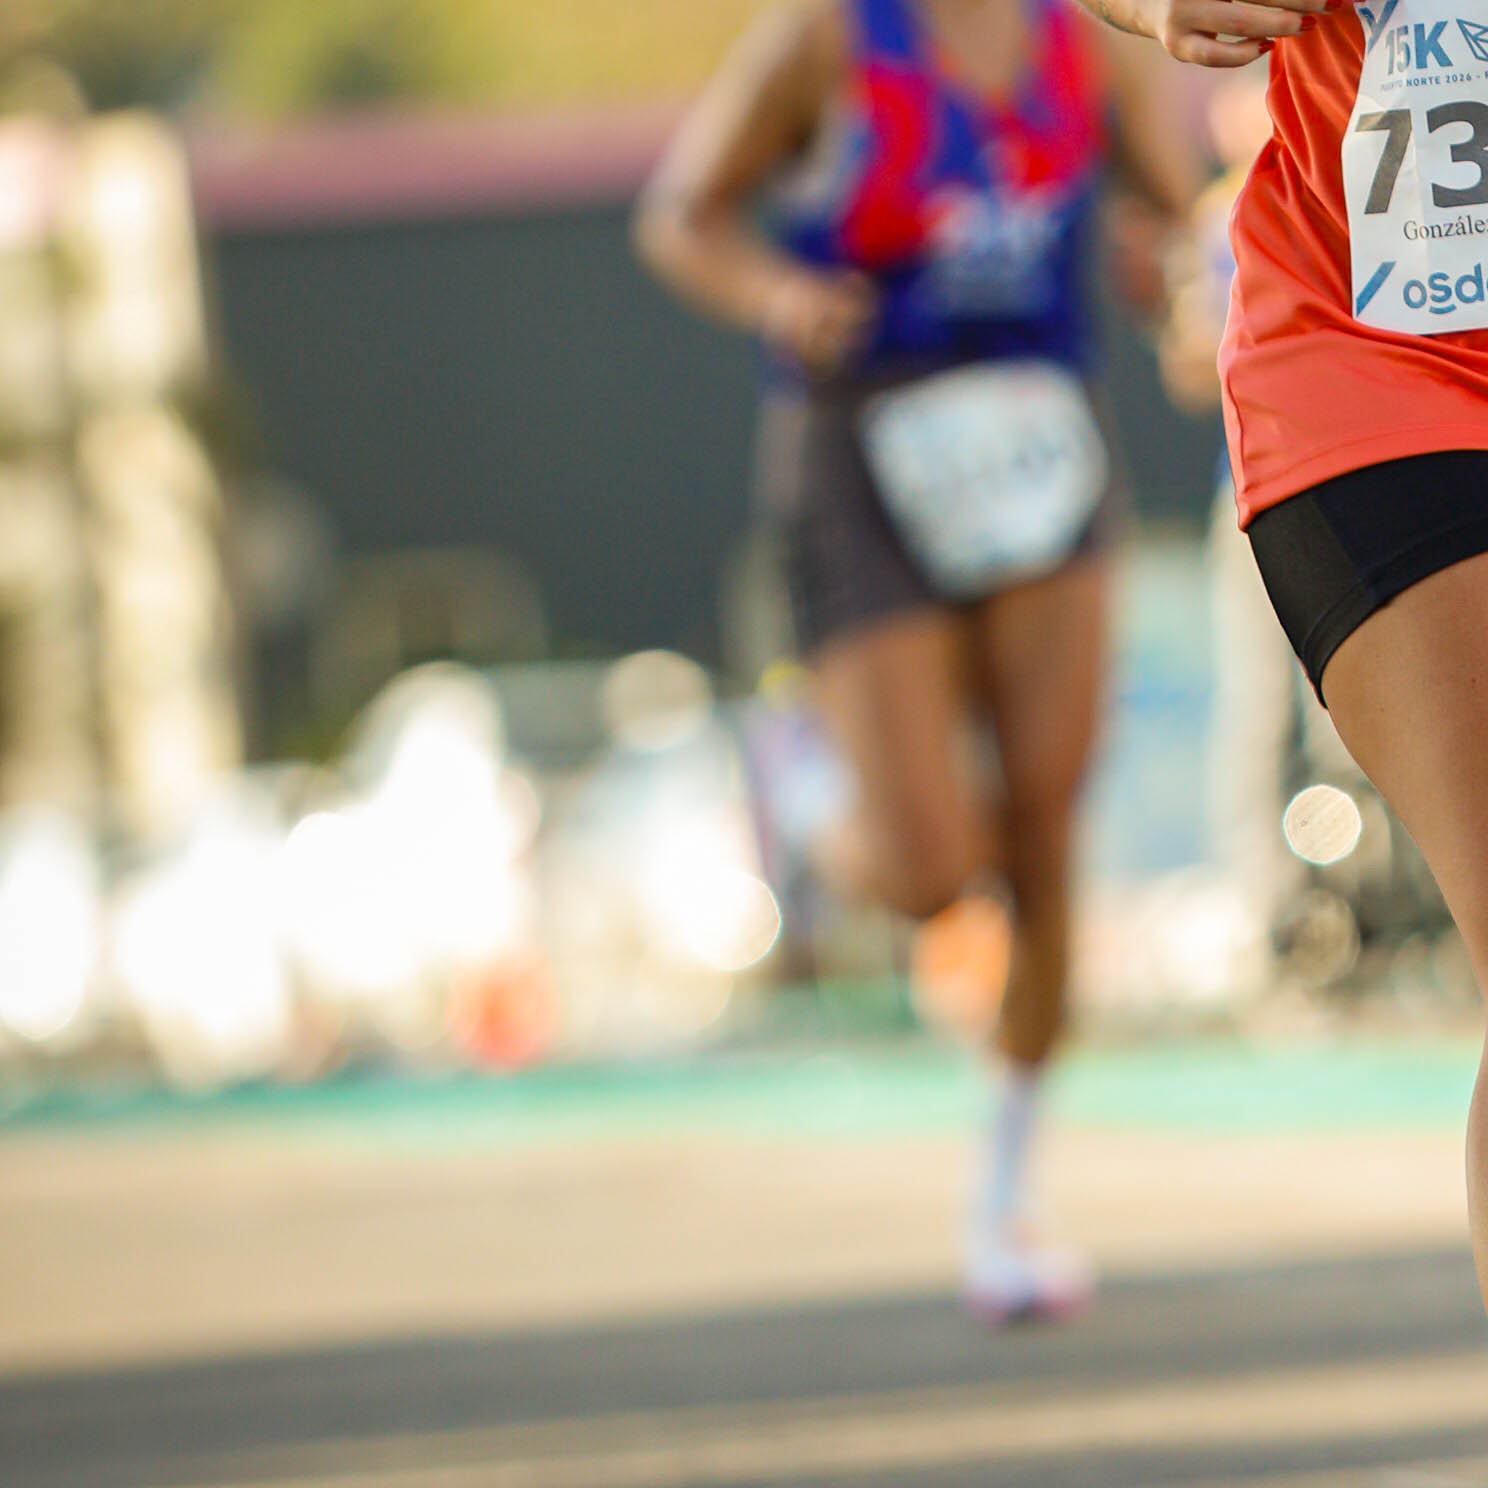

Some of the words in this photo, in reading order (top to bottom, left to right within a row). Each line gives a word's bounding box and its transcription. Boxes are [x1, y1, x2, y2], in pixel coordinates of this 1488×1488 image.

[1385, 20, 1454, 75] 15K
[1406, 75, 1441, 87] NORTE
[1446, 72, 1472, 84] 2026
